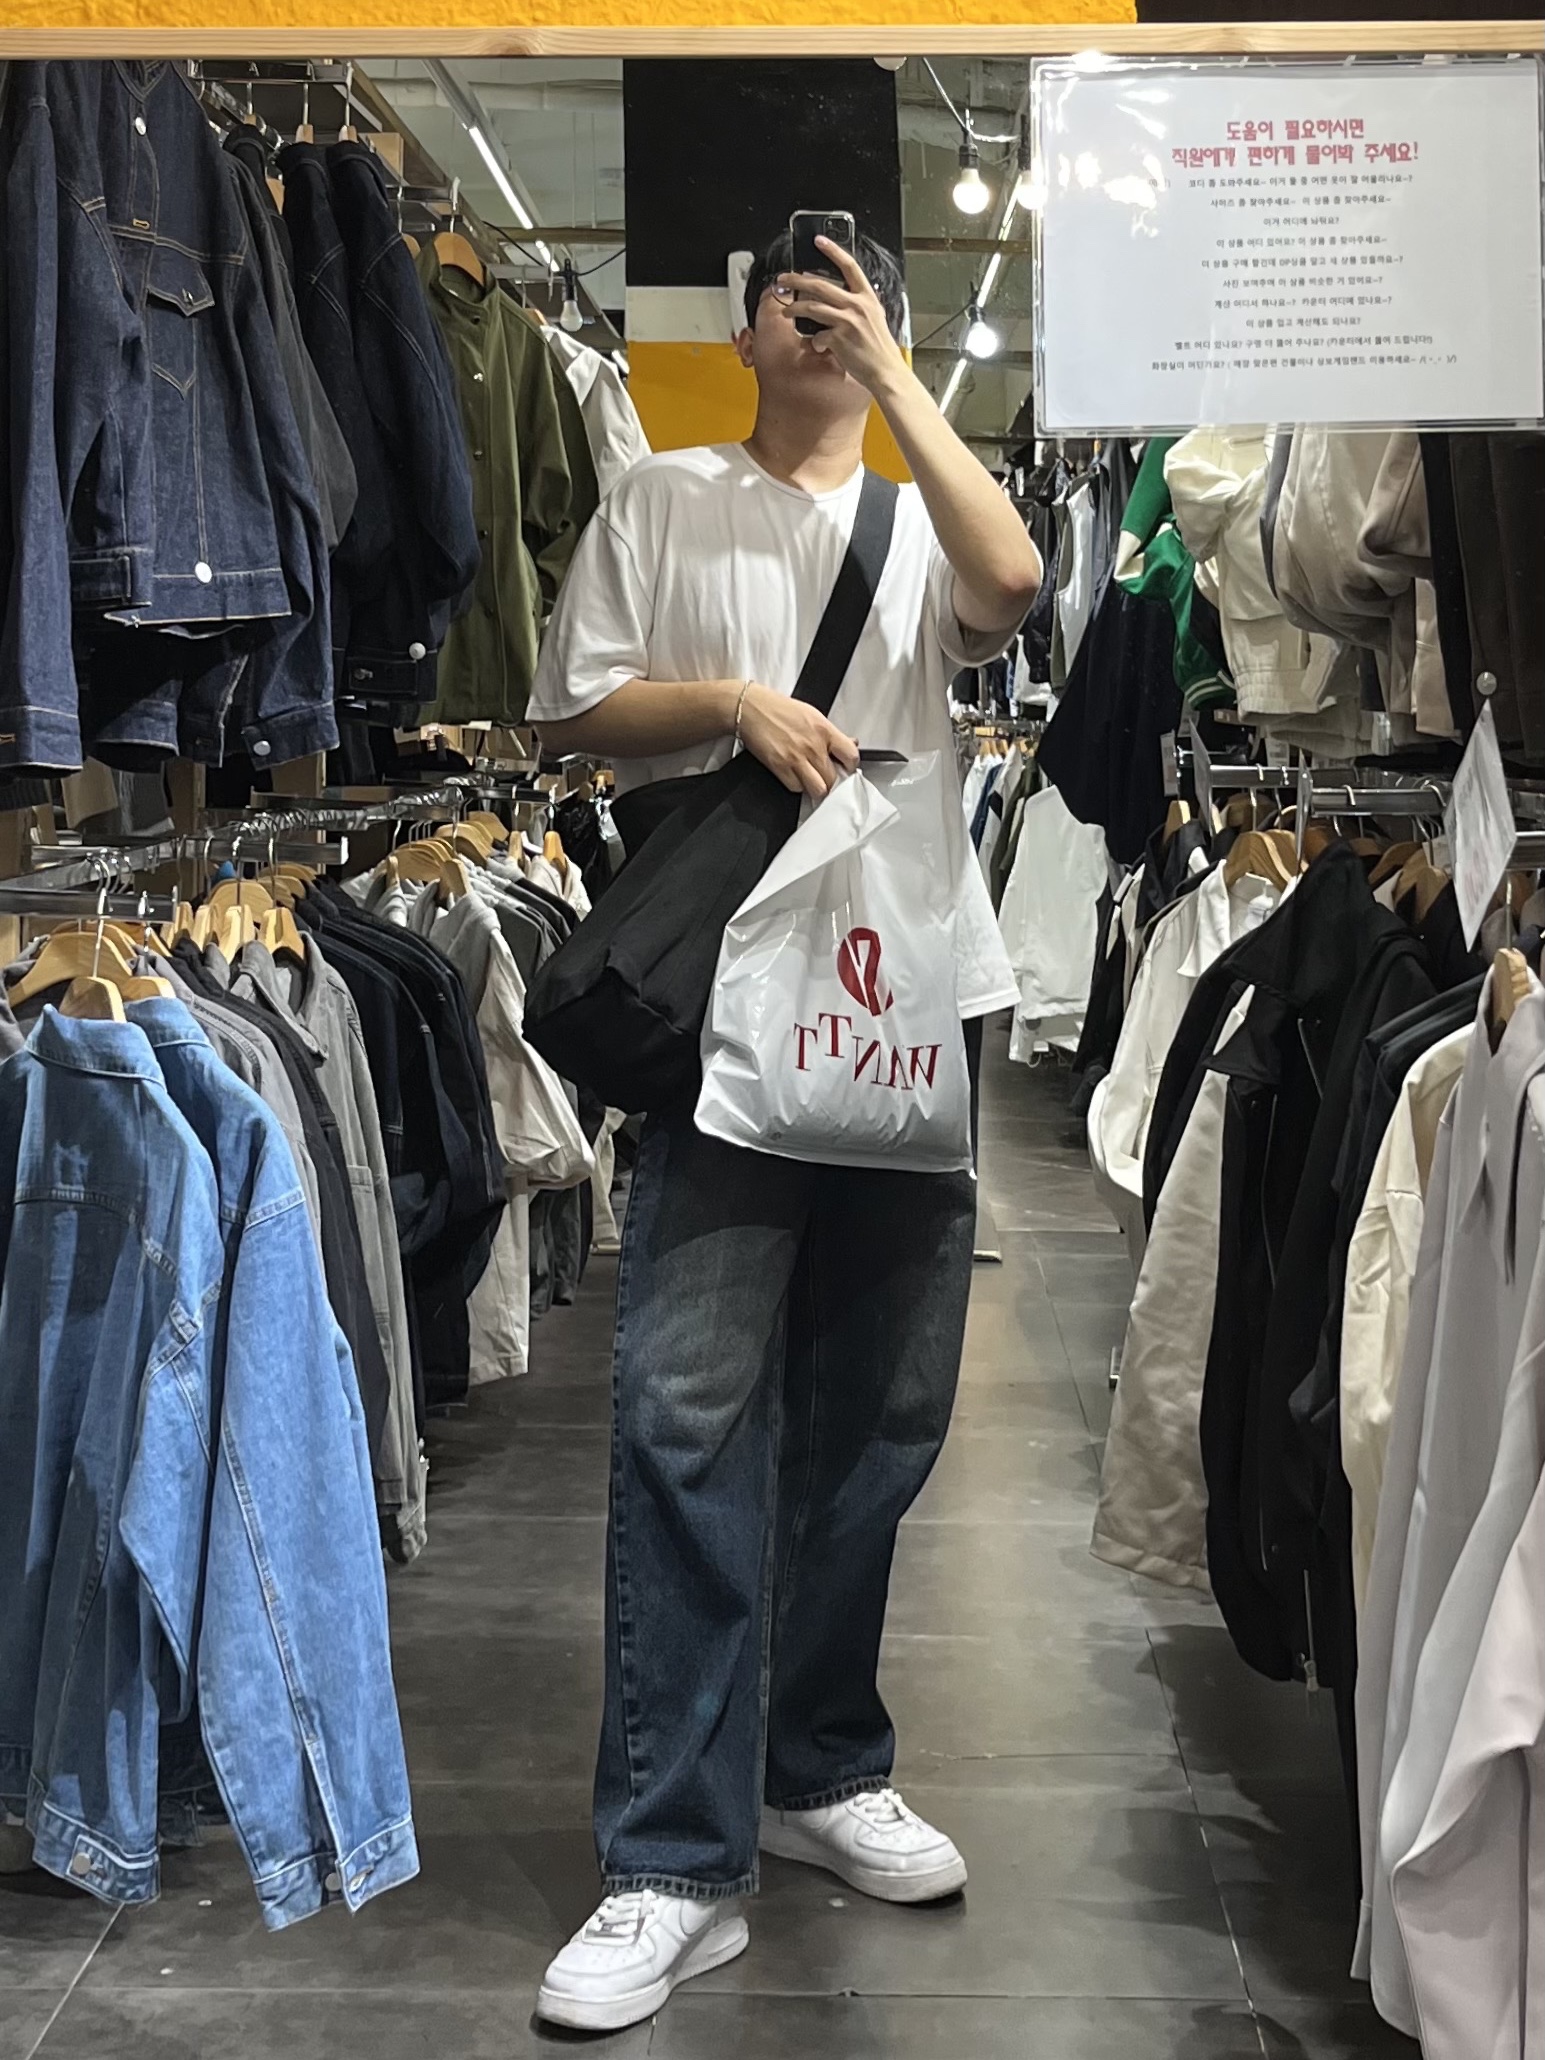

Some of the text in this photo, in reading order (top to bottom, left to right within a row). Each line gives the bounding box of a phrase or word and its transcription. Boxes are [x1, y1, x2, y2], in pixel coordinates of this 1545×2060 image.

[1227, 119, 1364, 141] 도움이 필요하시면
[1172, 141, 1418, 168] 직원에게 편하게 물어봐 주세요!
